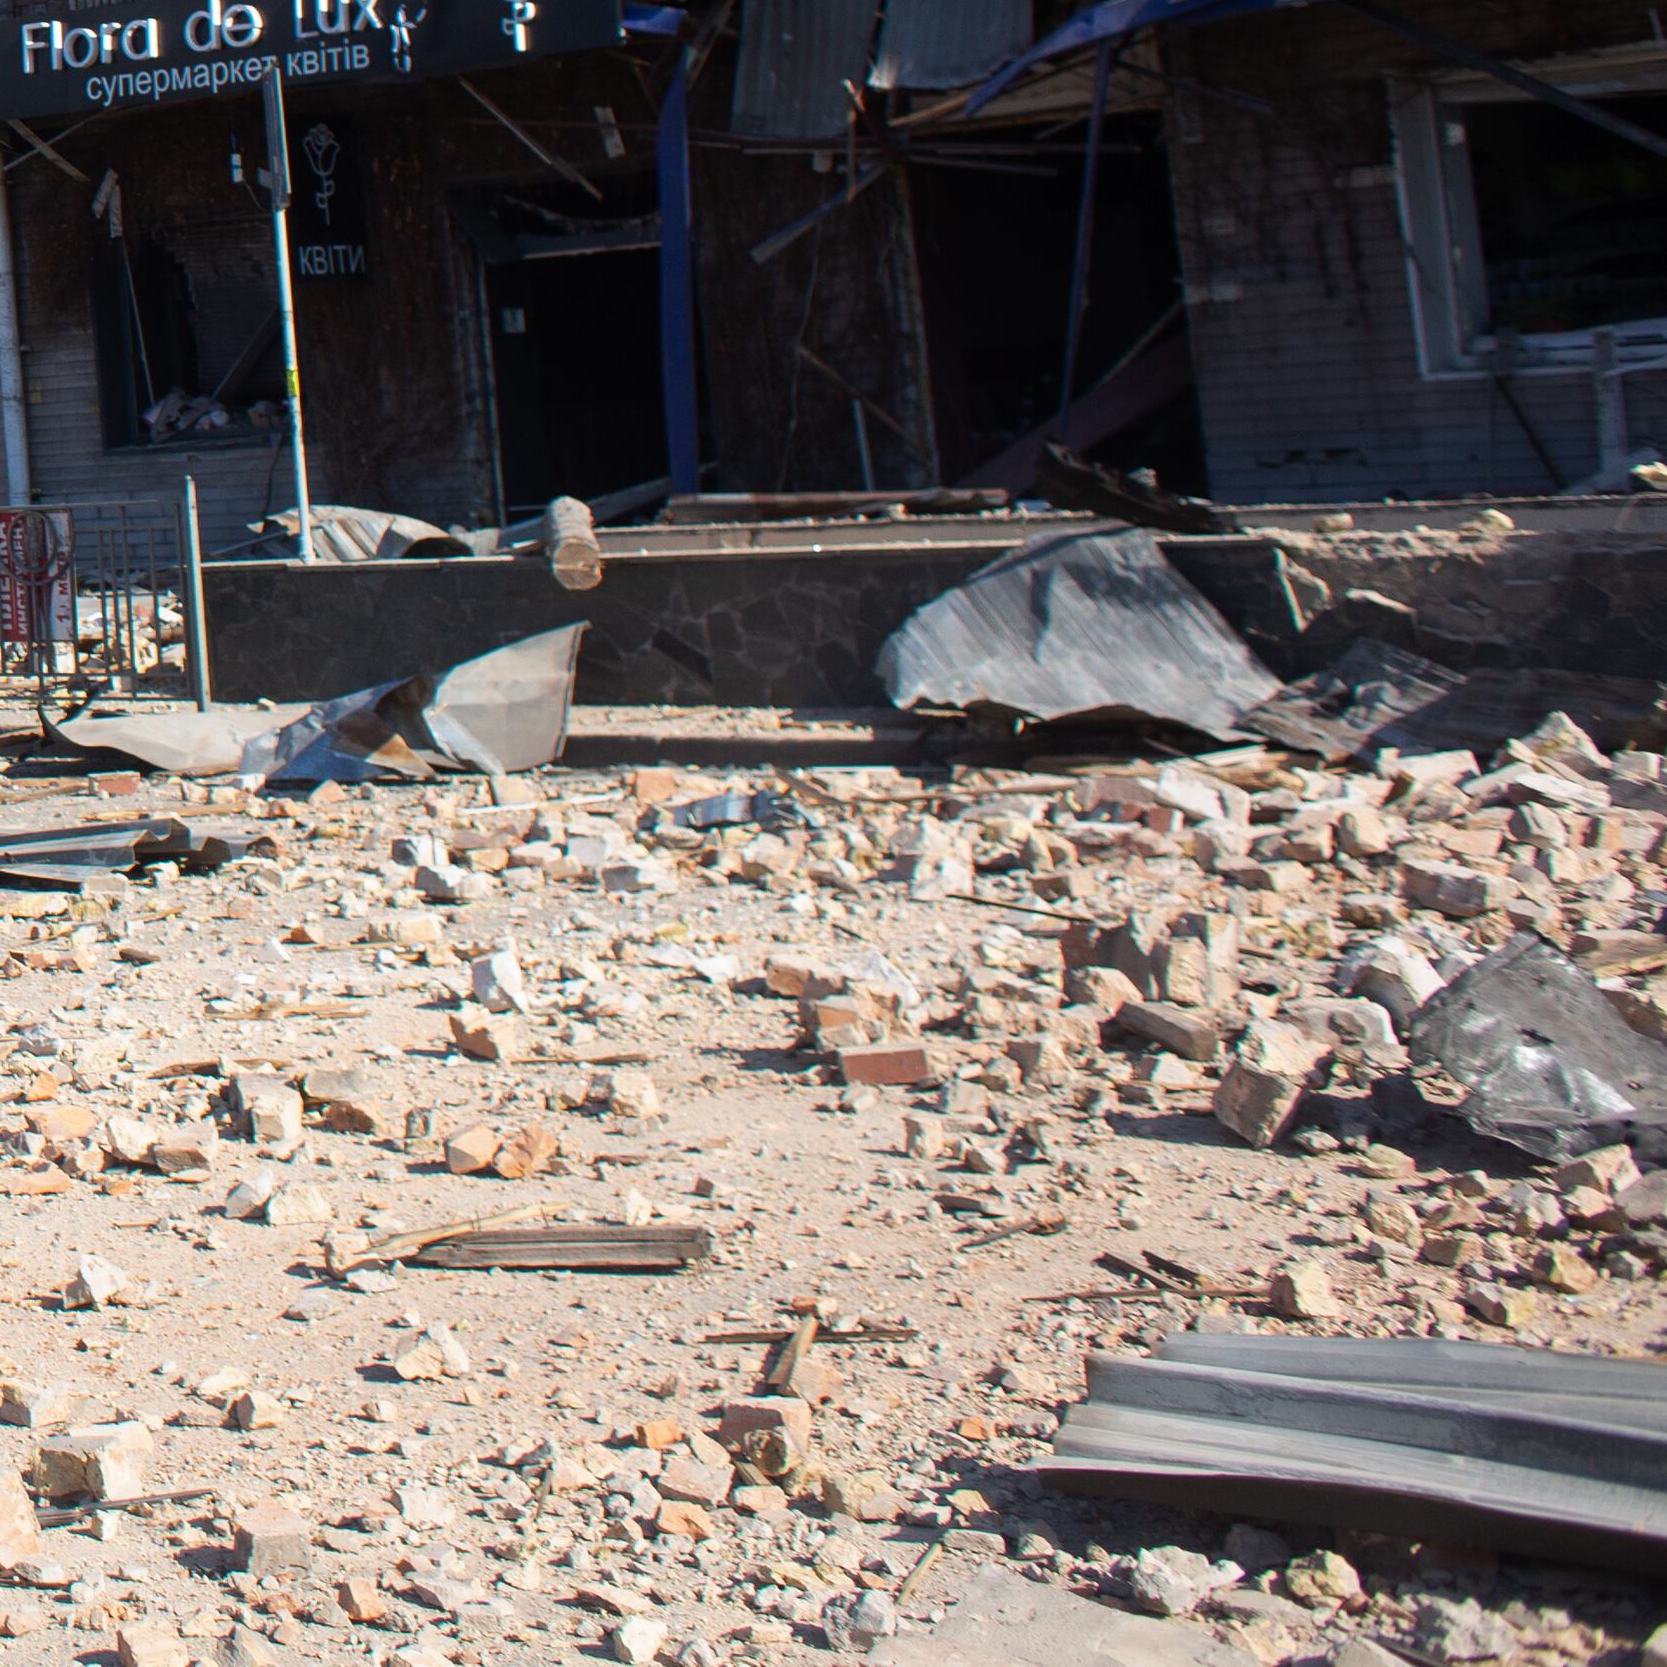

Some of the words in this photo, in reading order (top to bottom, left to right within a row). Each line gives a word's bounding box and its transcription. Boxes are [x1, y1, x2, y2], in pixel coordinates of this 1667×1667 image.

[21, 18, 159, 74] Flora
[86, 54, 277, 107] супермаркет
[286, 38, 370, 76] квітів
[298, 244, 366, 276] КВІТИ
